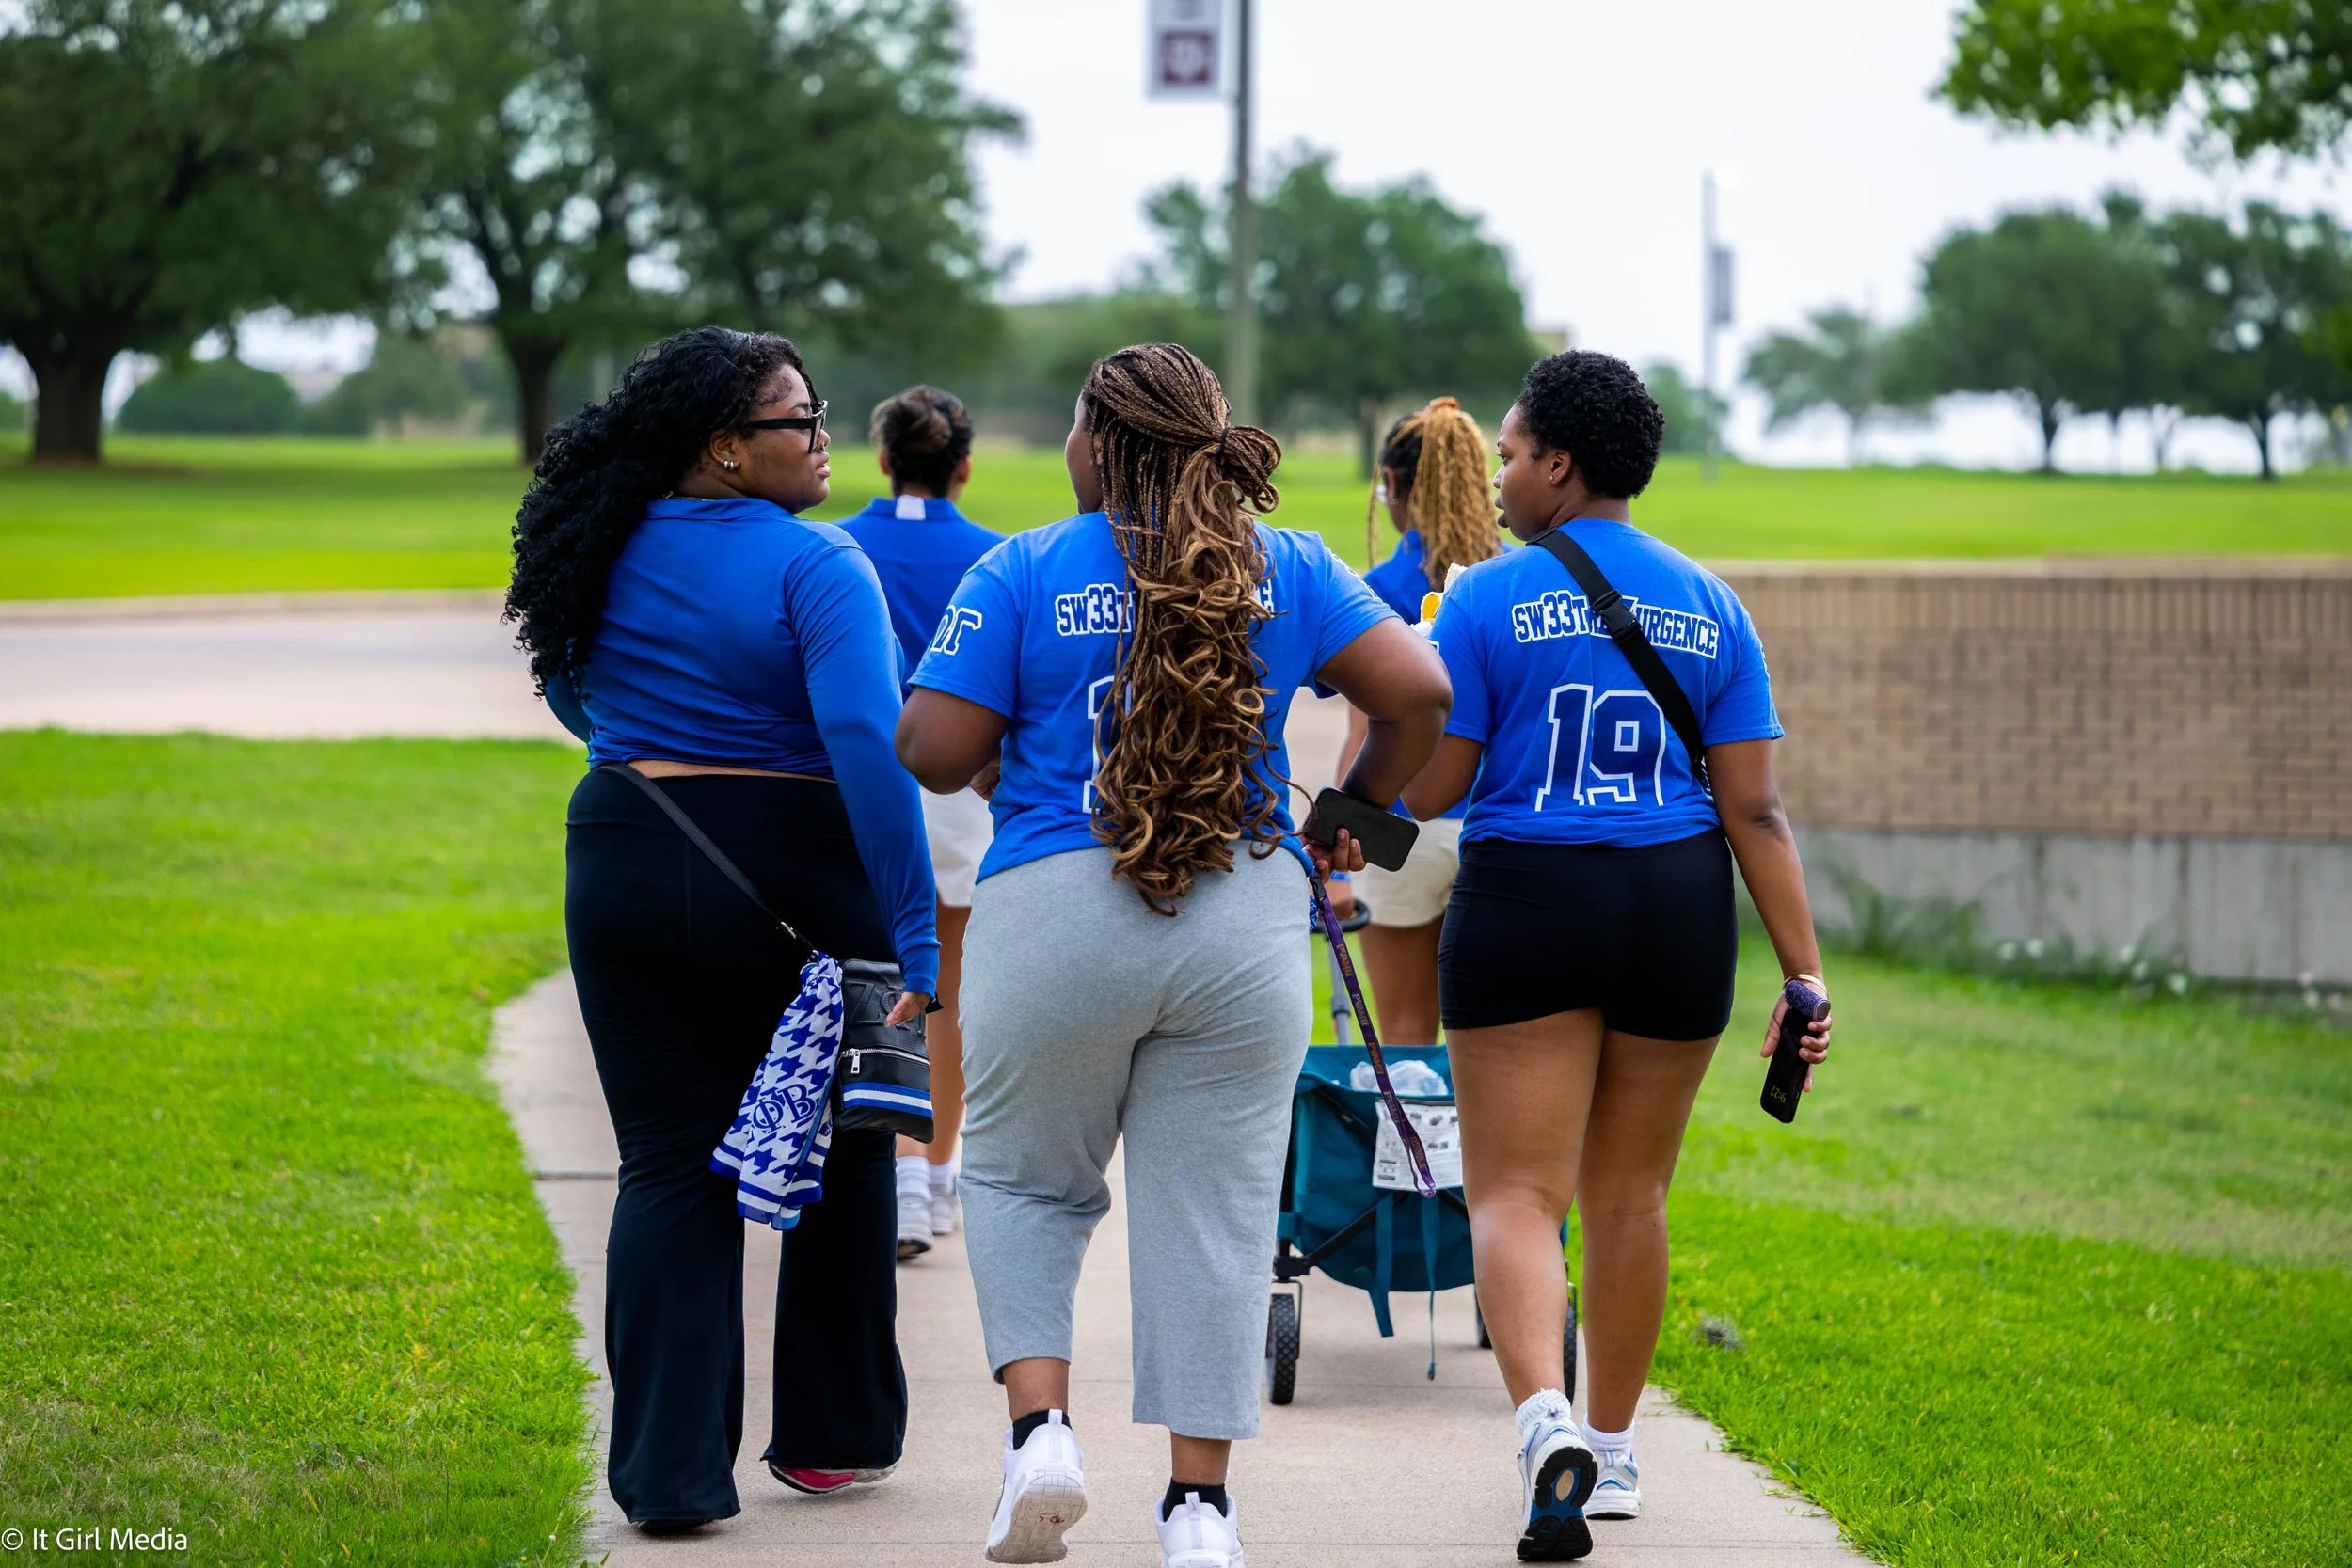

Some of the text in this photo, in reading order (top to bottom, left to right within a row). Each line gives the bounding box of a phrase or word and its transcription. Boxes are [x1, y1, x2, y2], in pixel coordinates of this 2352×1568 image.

[1534, 683, 1666, 812] 19
[1336, 943, 1354, 977] PVAMU
[1352, 992, 1369, 1026] PVAMU
